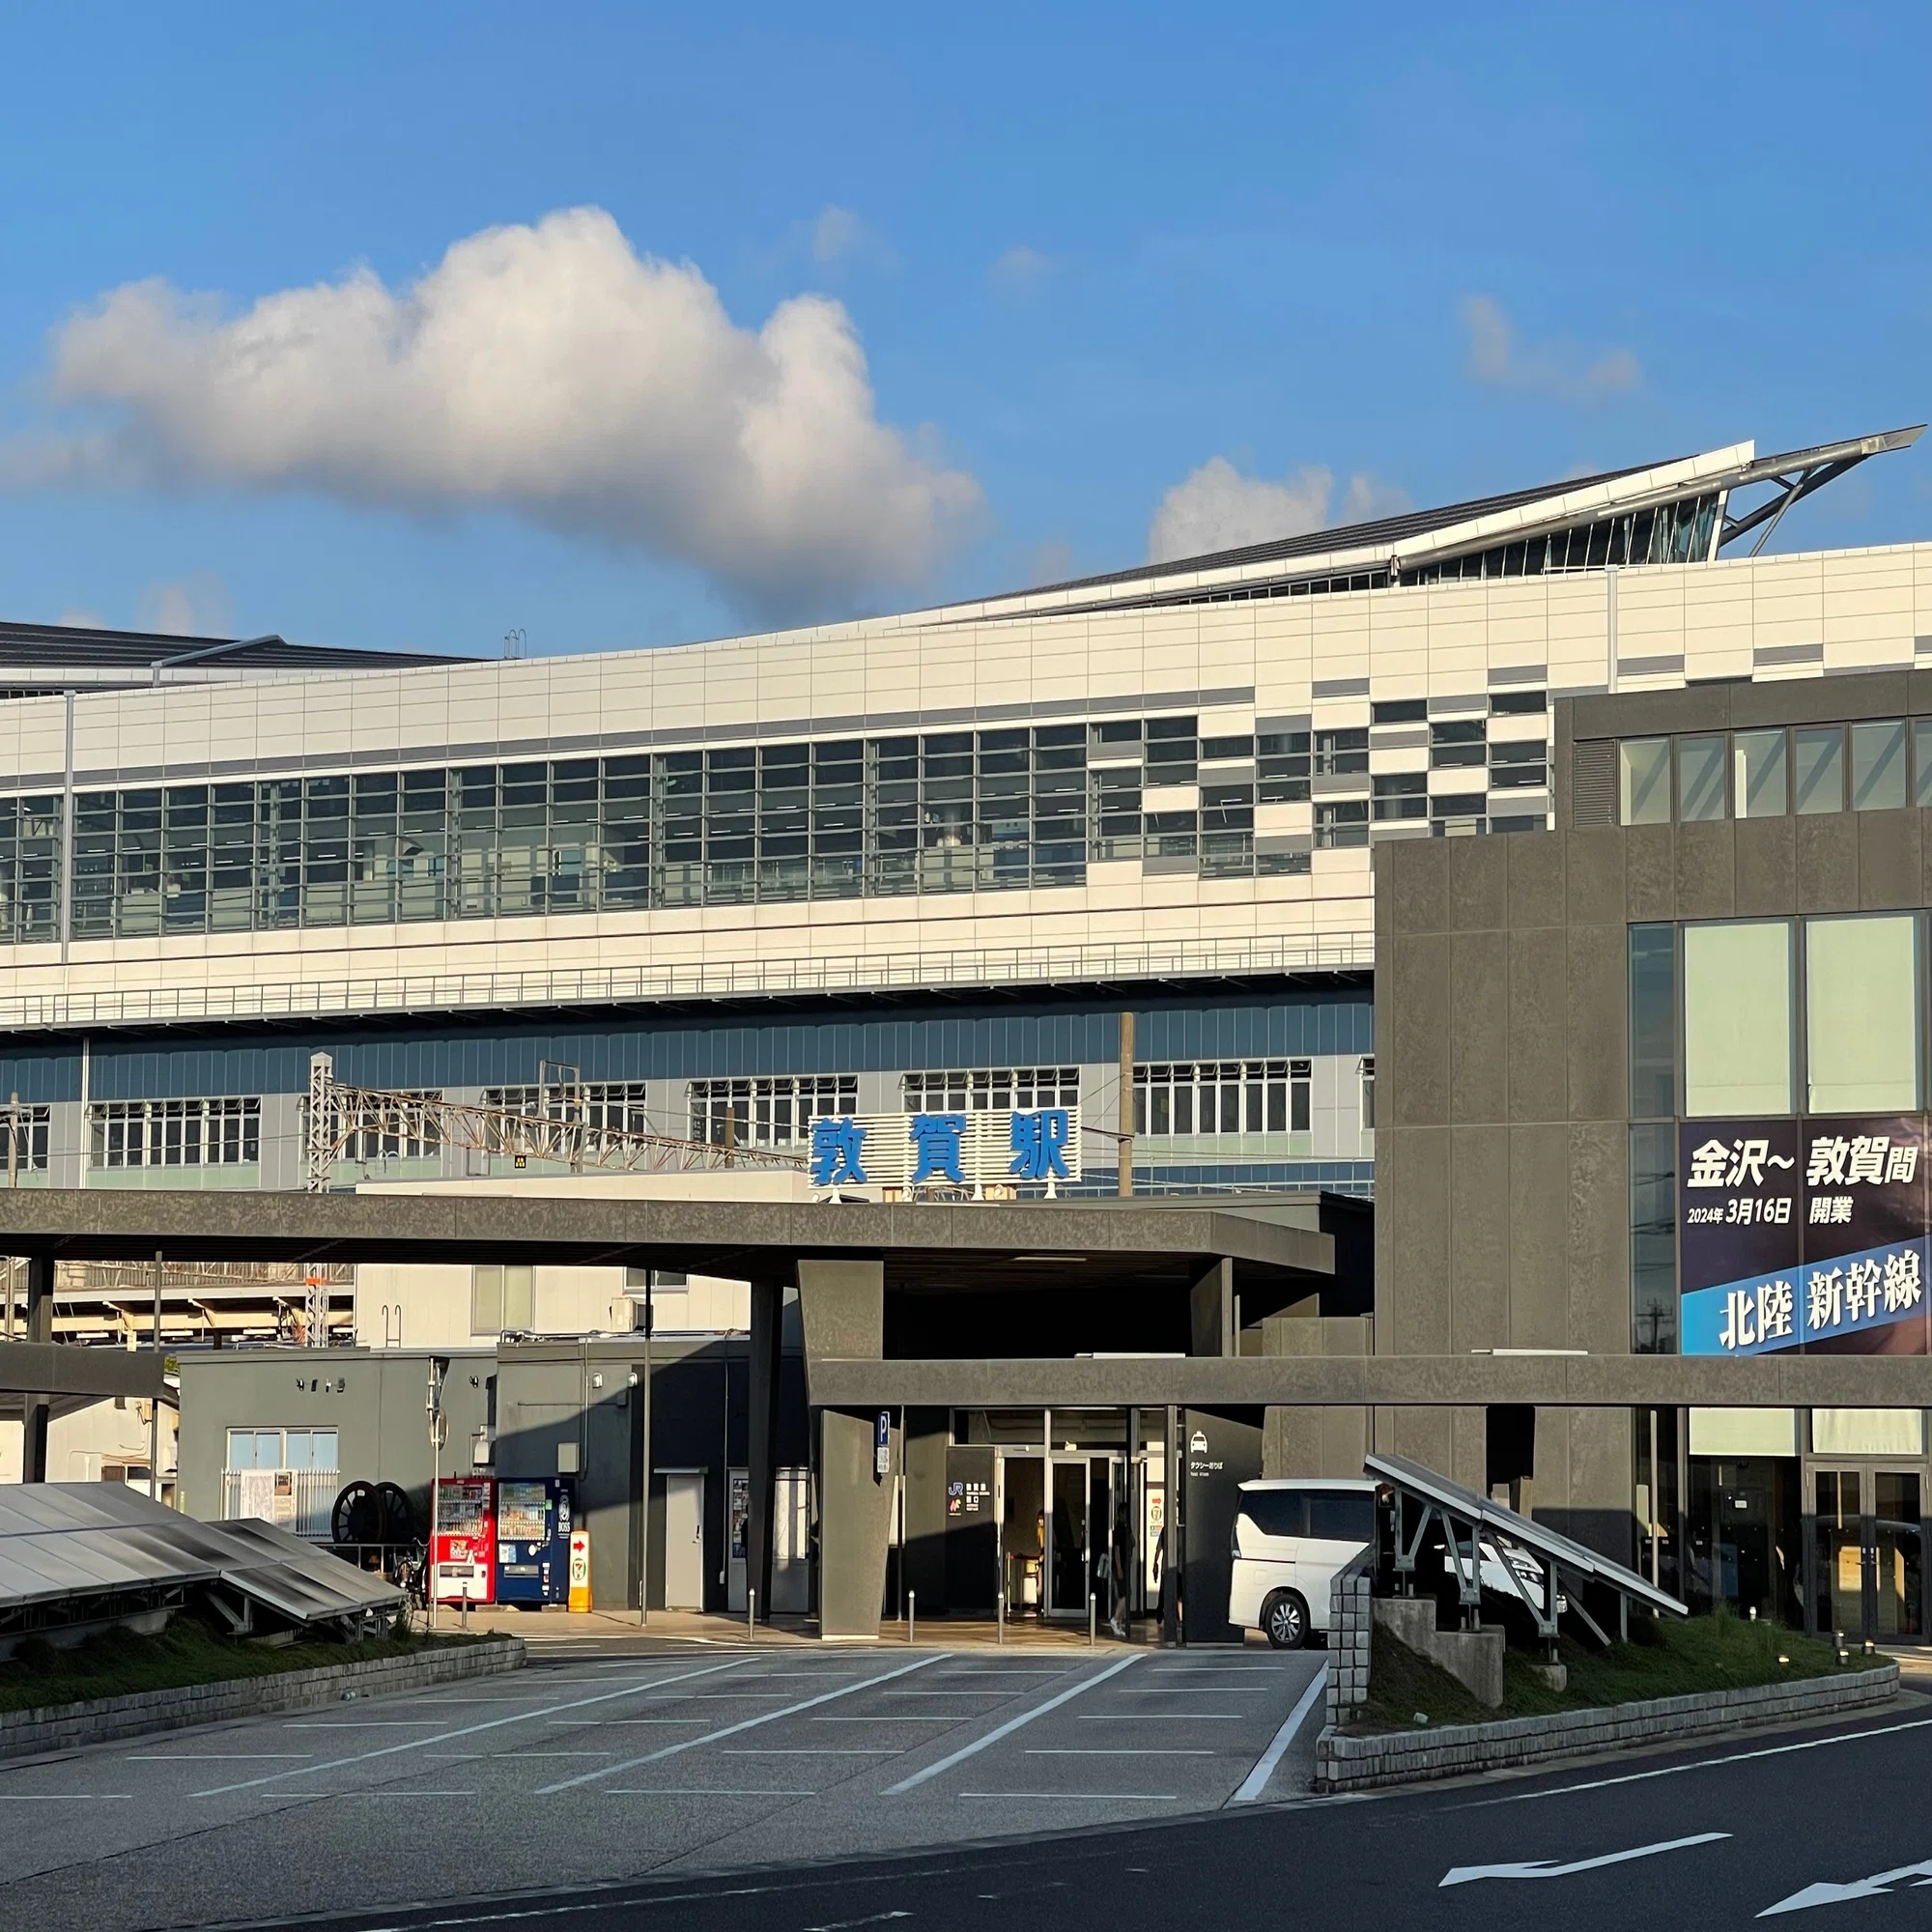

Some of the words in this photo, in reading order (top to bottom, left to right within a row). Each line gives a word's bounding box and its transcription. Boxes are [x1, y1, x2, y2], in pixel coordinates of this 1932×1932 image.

[811, 1109, 1070, 1185] 敦賀駅
[1806, 1135, 1918, 1186] 敦賀間
[1808, 1196, 1855, 1224] 開業
[1719, 1280, 1794, 1350] 北陸
[1806, 1249, 1922, 1330] 新幹線
[880, 1415, 888, 1442] P
[948, 1482, 964, 1496] JR
[557, 1521, 571, 1533] BOSS
